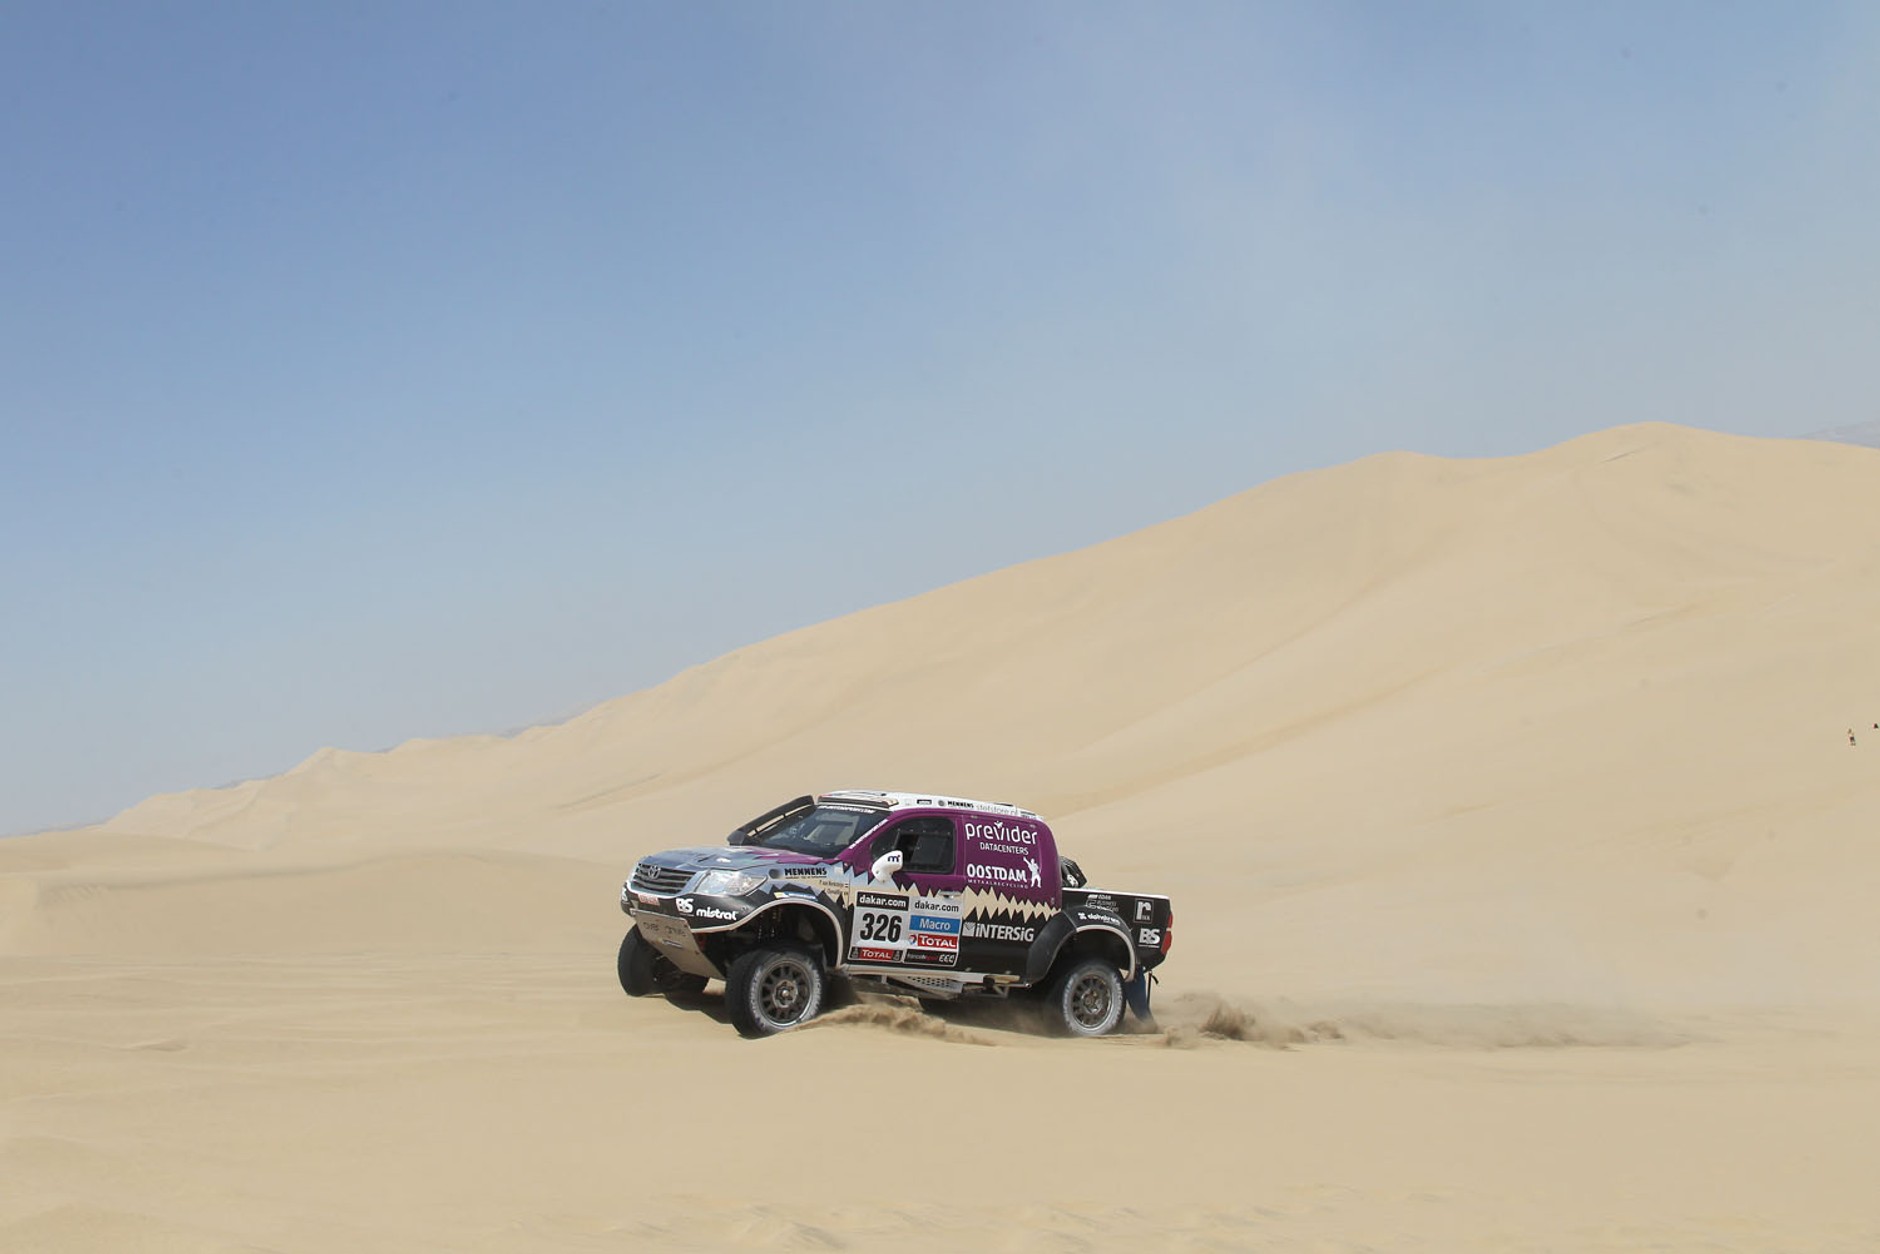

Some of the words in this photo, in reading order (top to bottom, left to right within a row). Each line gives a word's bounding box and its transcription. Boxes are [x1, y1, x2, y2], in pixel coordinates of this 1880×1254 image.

[965, 821, 1038, 844] previder
[980, 842, 1029, 855] DATACENTERS
[784, 868, 828, 876] MENNENS
[966, 864, 1028, 882] OOSTDAM
[860, 894, 906, 908] dakar.com
[915, 901, 960, 912] dakar.com
[696, 906, 738, 921] mistral
[860, 912, 903, 942] 326
[920, 918, 951, 930] Macro
